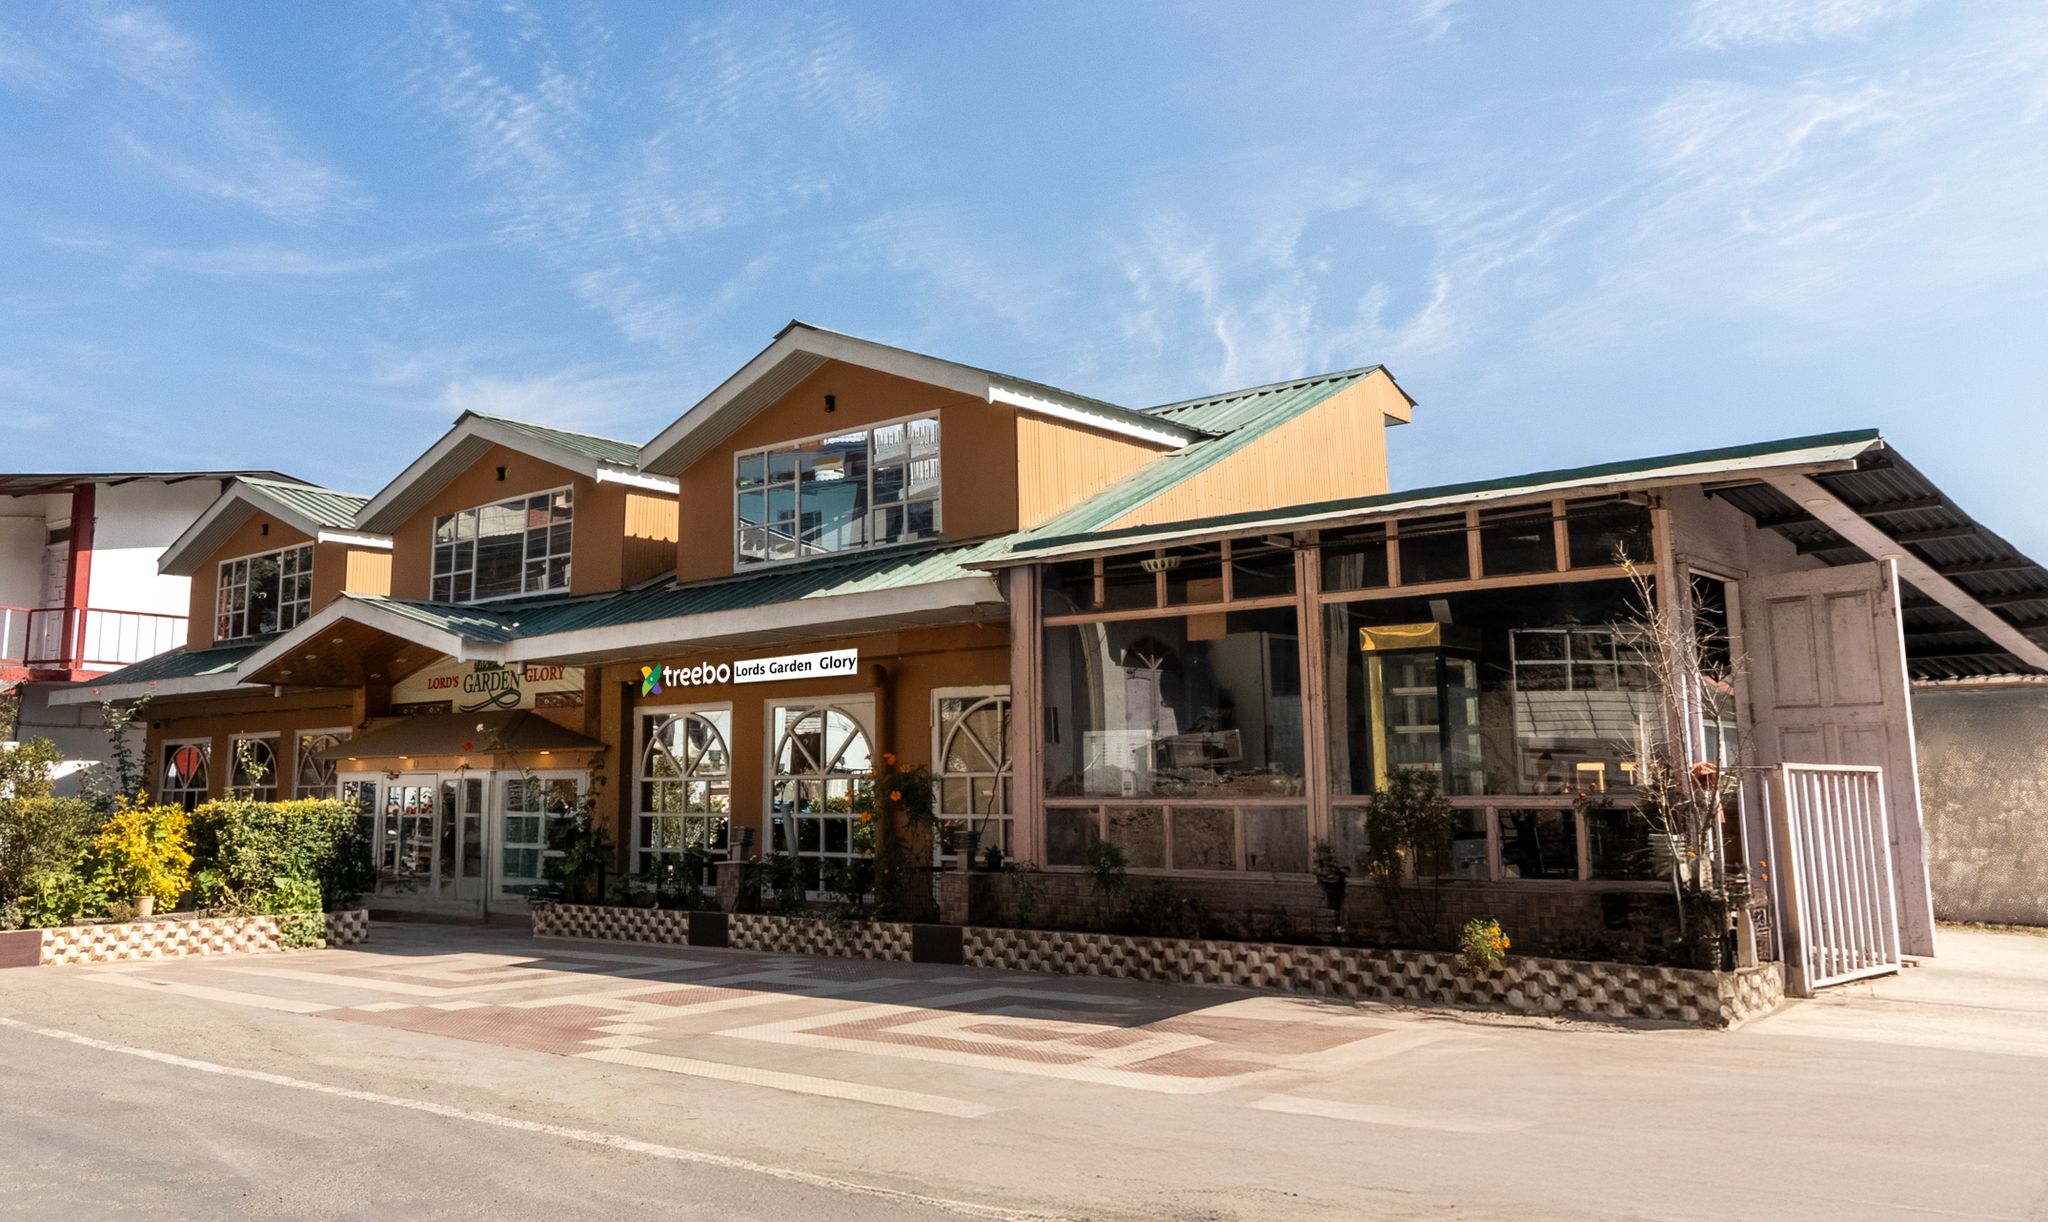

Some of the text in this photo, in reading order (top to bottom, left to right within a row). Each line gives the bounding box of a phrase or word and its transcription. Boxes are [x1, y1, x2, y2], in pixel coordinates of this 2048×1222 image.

[428, 665, 565, 693] LORD'S GARDEN GLORY
[663, 661, 731, 687] treebo
[735, 655, 857, 677] Lords Garden Glory
